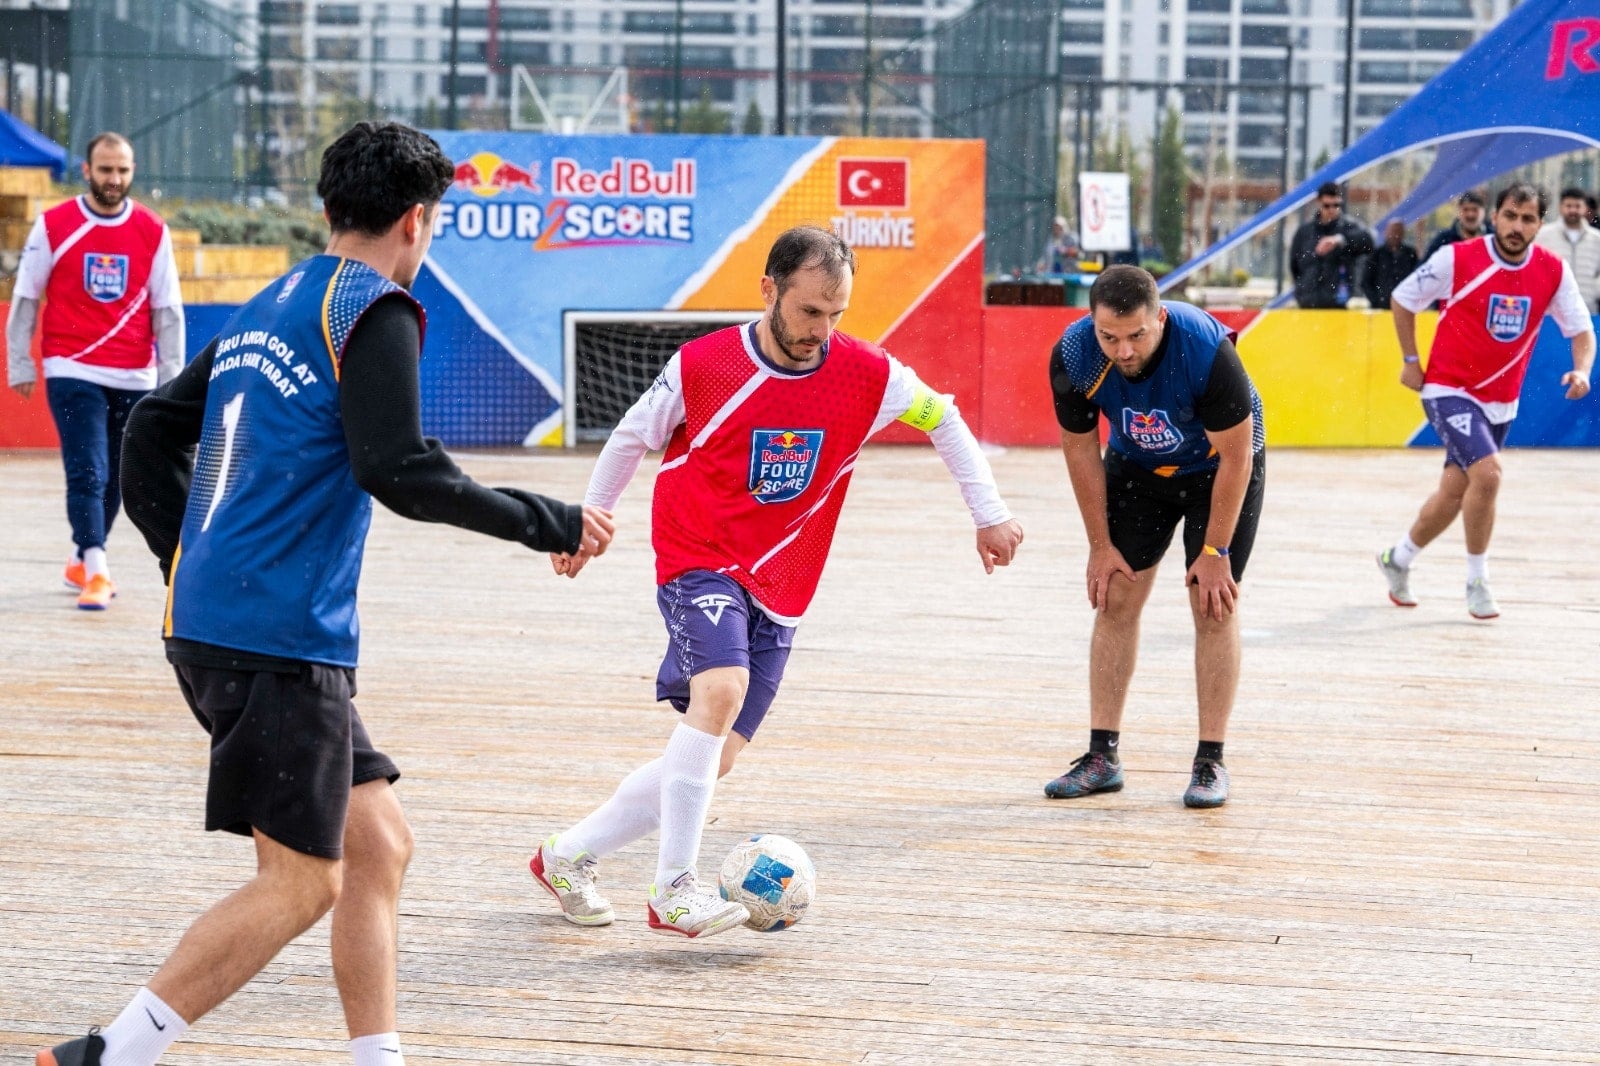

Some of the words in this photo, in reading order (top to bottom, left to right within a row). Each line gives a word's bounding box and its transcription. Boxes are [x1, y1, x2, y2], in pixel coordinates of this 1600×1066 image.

[552, 157, 623, 197] Red
[626, 158, 697, 198] Bull
[208, 354, 241, 382] HADA
[260, 357, 299, 398] YARAT
[240, 331, 269, 347] ANDA
[267, 335, 295, 366] GOL
[291, 363, 318, 386] AT
[1131, 429, 1176, 443] FOUR
[201, 392, 245, 532] 1
[759, 463, 808, 479] FOUR
